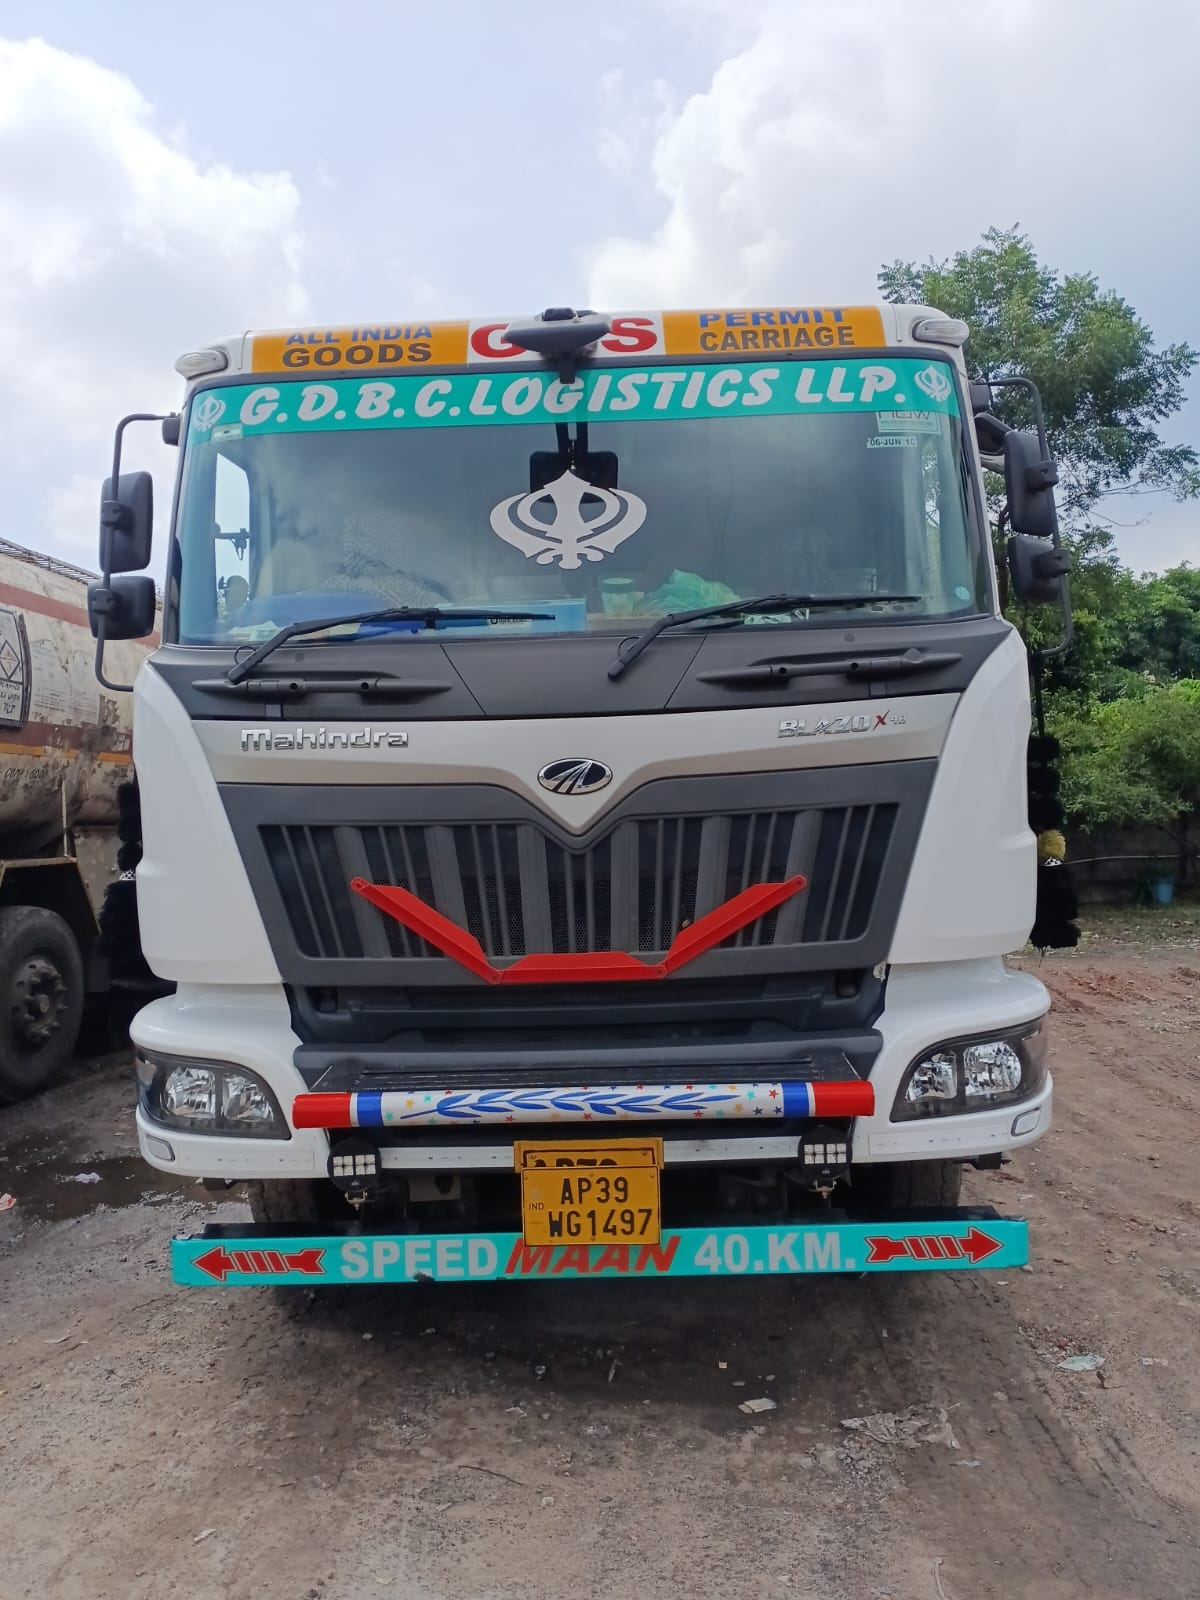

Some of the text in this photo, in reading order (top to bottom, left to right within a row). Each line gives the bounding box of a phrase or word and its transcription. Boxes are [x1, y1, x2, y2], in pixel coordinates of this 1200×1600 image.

[699, 308, 847, 329] PERMIT
[284, 324, 434, 346] ALL INDIA
[470, 317, 658, 358] GS
[699, 325, 855, 352] CARRIAGE
[281, 342, 433, 368] GOODS
[795, 365, 906, 404] LLP.
[241, 727, 409, 751] Mahindra
[778, 714, 871, 738] BLAZO
[560, 1176, 629, 1205] AP39
[528, 1202, 545, 1211] IND
[548, 1208, 652, 1238] WG1497
[341, 1237, 497, 1279] SPEED
[693, 1231, 856, 1274] 40.KM.
